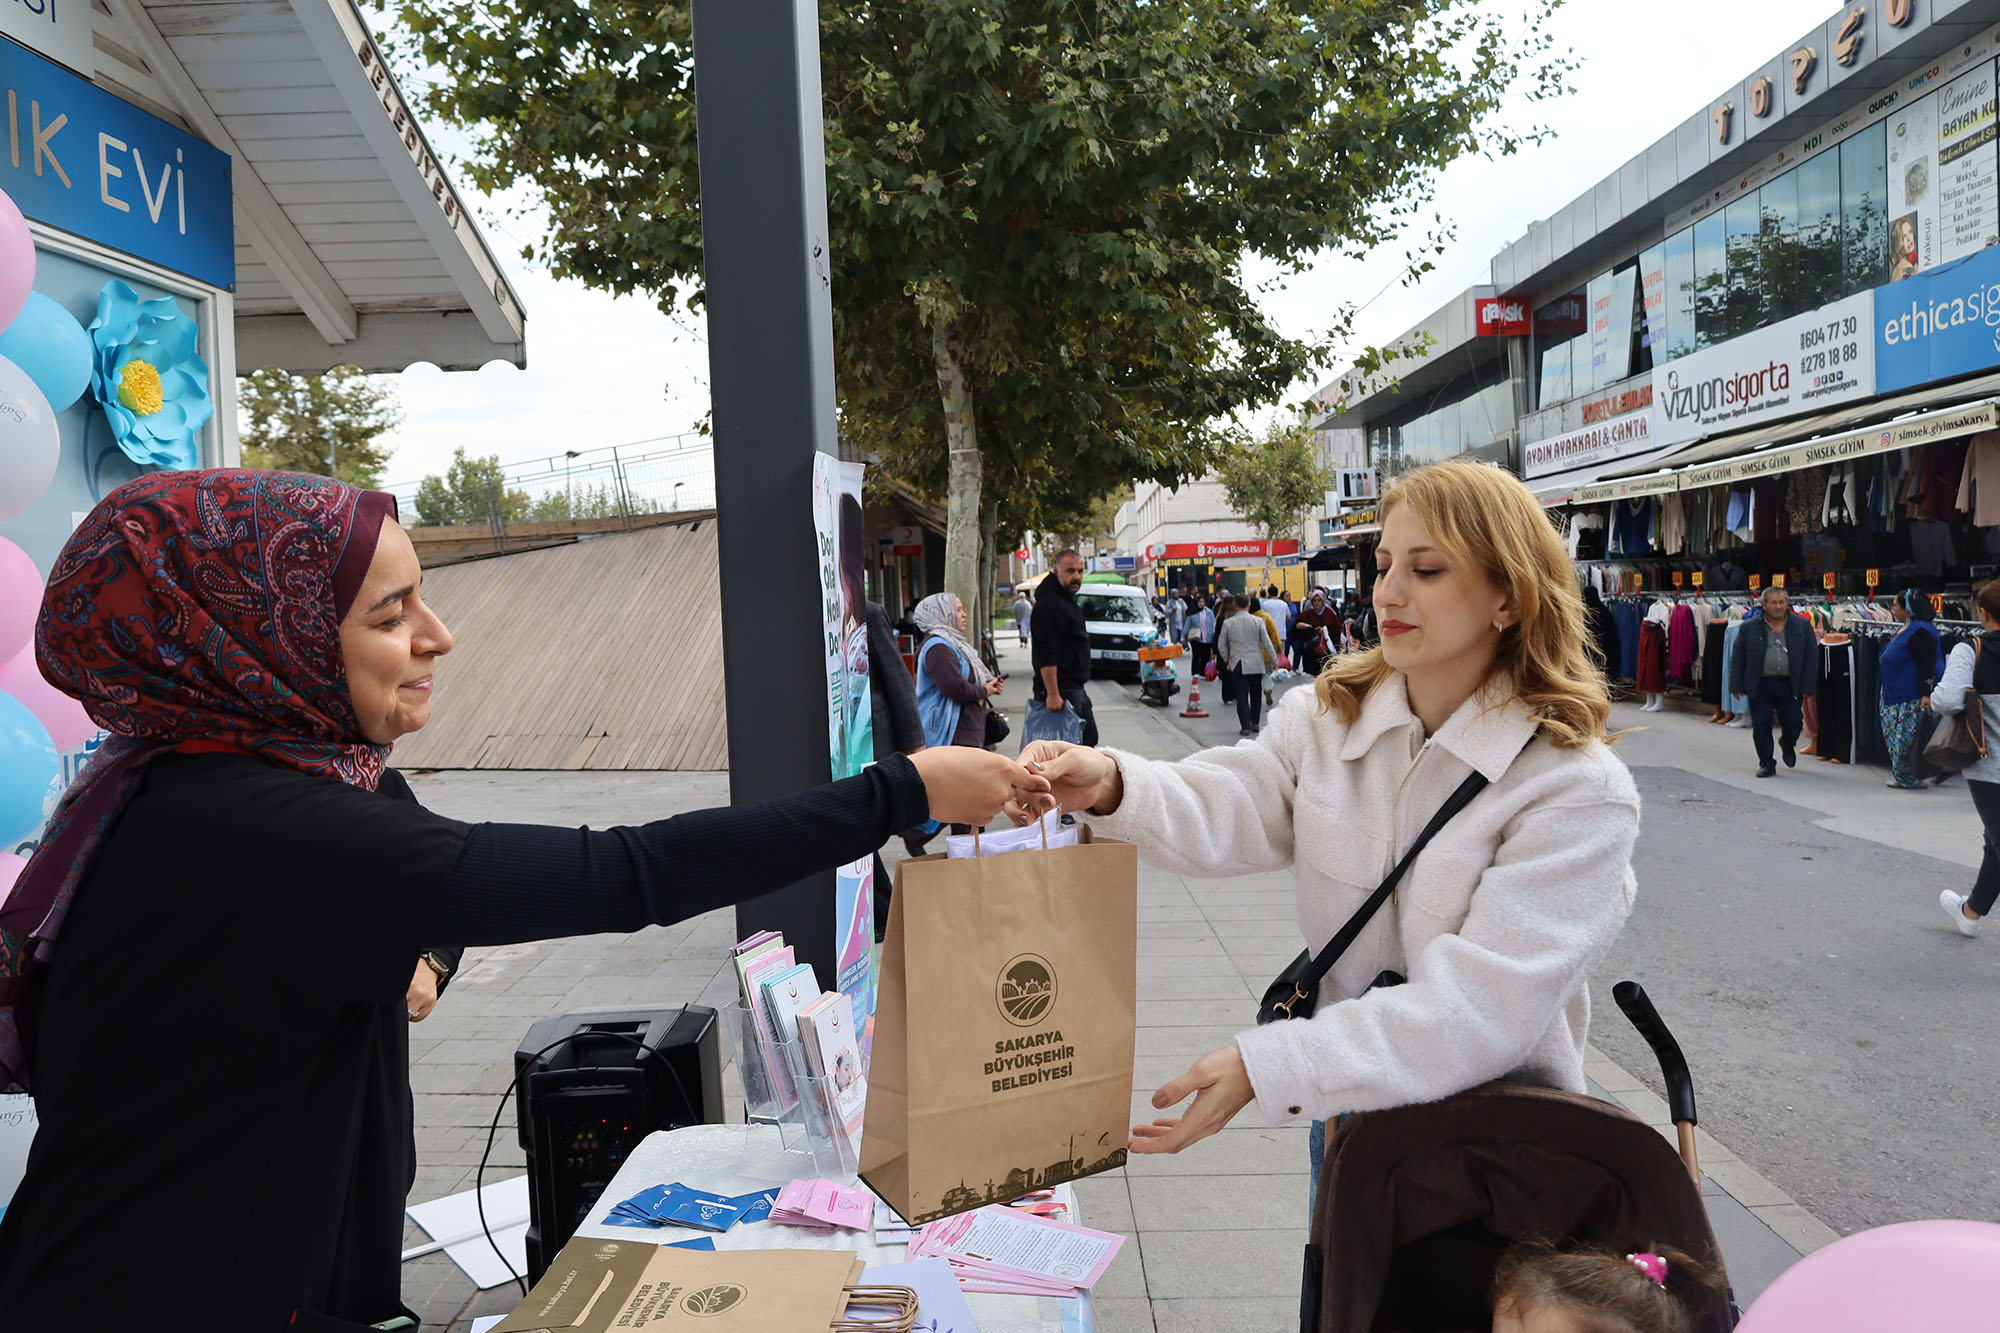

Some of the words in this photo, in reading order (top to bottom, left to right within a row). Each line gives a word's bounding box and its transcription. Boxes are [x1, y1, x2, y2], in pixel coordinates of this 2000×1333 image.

[1943, 107, 1978, 138] BAYAN
[1804, 134, 1822, 153] HDI
[1805, 327, 1825, 349] 604
[1827, 321, 1840, 342] 77
[1842, 316, 1857, 337] 30
[1806, 352, 1826, 374] 278
[1828, 347, 1840, 367] 18
[1843, 342, 1857, 362] 88
[1526, 443, 1552, 466] AYDIN
[1554, 430, 1601, 459] AYAKKABI
[1207, 545, 1229, 555] Ziraat
[994, 1030, 1064, 1054] SAKARYA
[983, 1044, 1075, 1076] BÜYÜKŞEHİR
[991, 1061, 1073, 1093] BELEDİYESİ
[616, 1284, 654, 1328] BELEDİYESİ
[632, 1281, 672, 1328] BÜYÜKŞEHİR
[652, 1286, 683, 1321] SAKARYA
